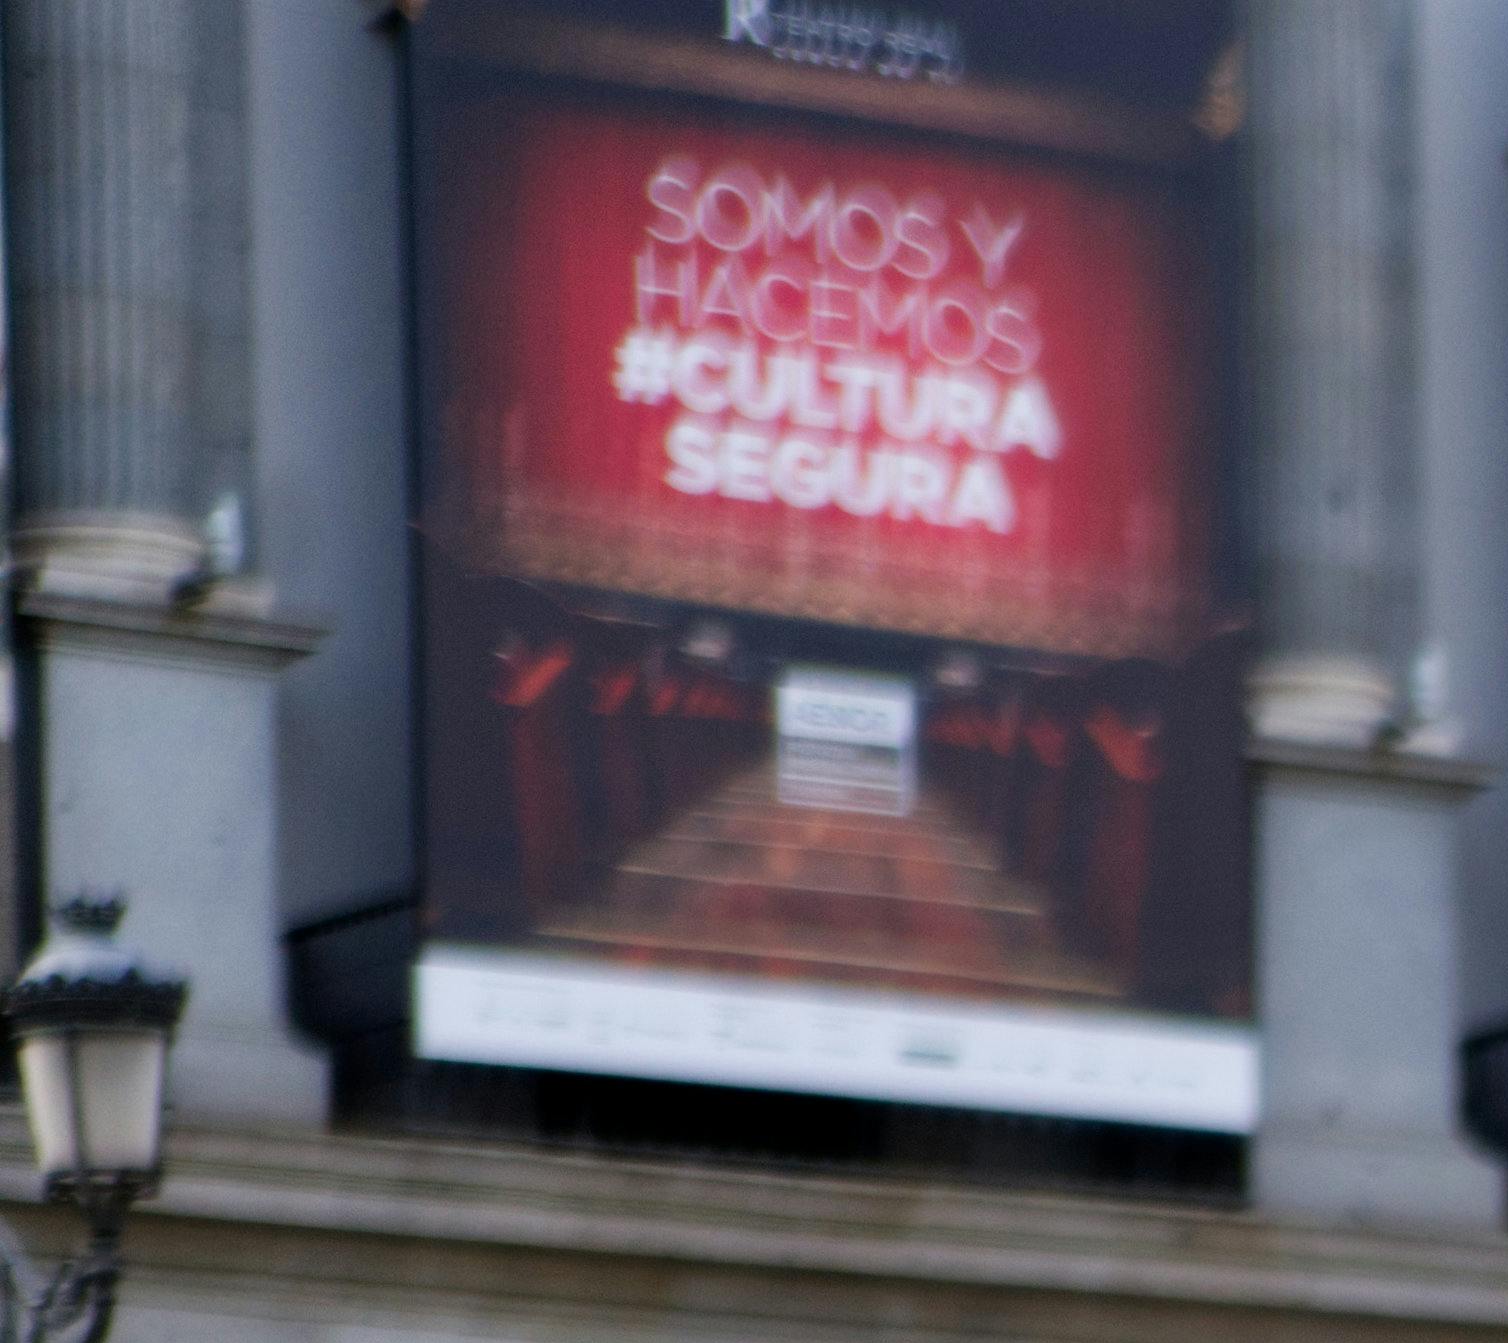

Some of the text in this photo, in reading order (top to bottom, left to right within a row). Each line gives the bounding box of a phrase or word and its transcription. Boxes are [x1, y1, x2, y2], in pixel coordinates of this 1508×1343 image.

[646, 164, 1025, 288] SOMOS Y
[634, 243, 1042, 374] HACEMOS
[613, 325, 1062, 461] #CULTURA
[664, 418, 1017, 534] SEGURA
